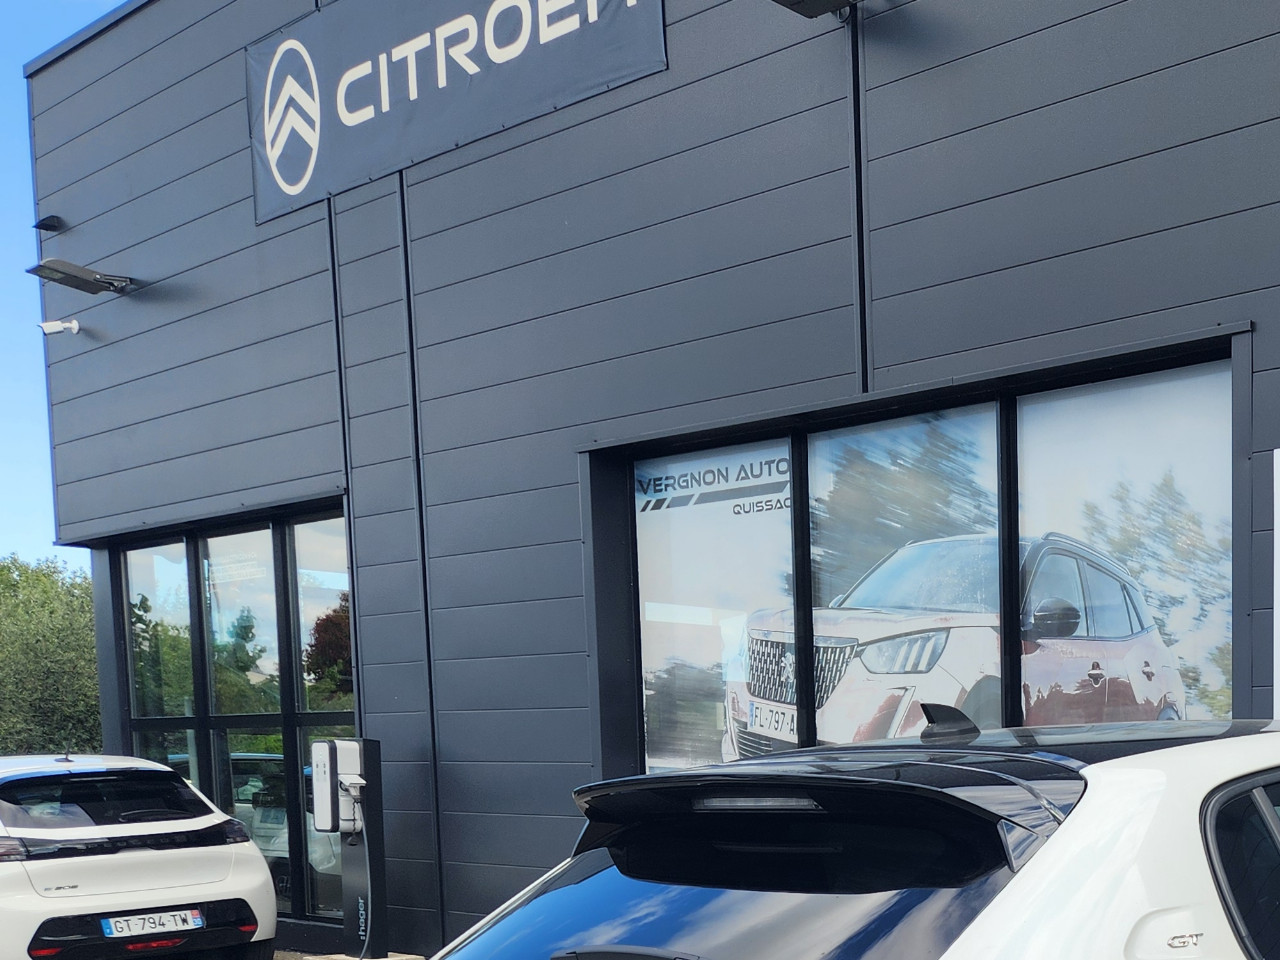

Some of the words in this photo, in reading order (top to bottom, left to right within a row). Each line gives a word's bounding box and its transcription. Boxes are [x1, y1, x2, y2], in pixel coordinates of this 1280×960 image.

[637, 466, 729, 495] VERGNON
[735, 457, 790, 482] AUTO
[732, 497, 791, 515] QUISSAC
[1167, 932, 1204, 948] GT
